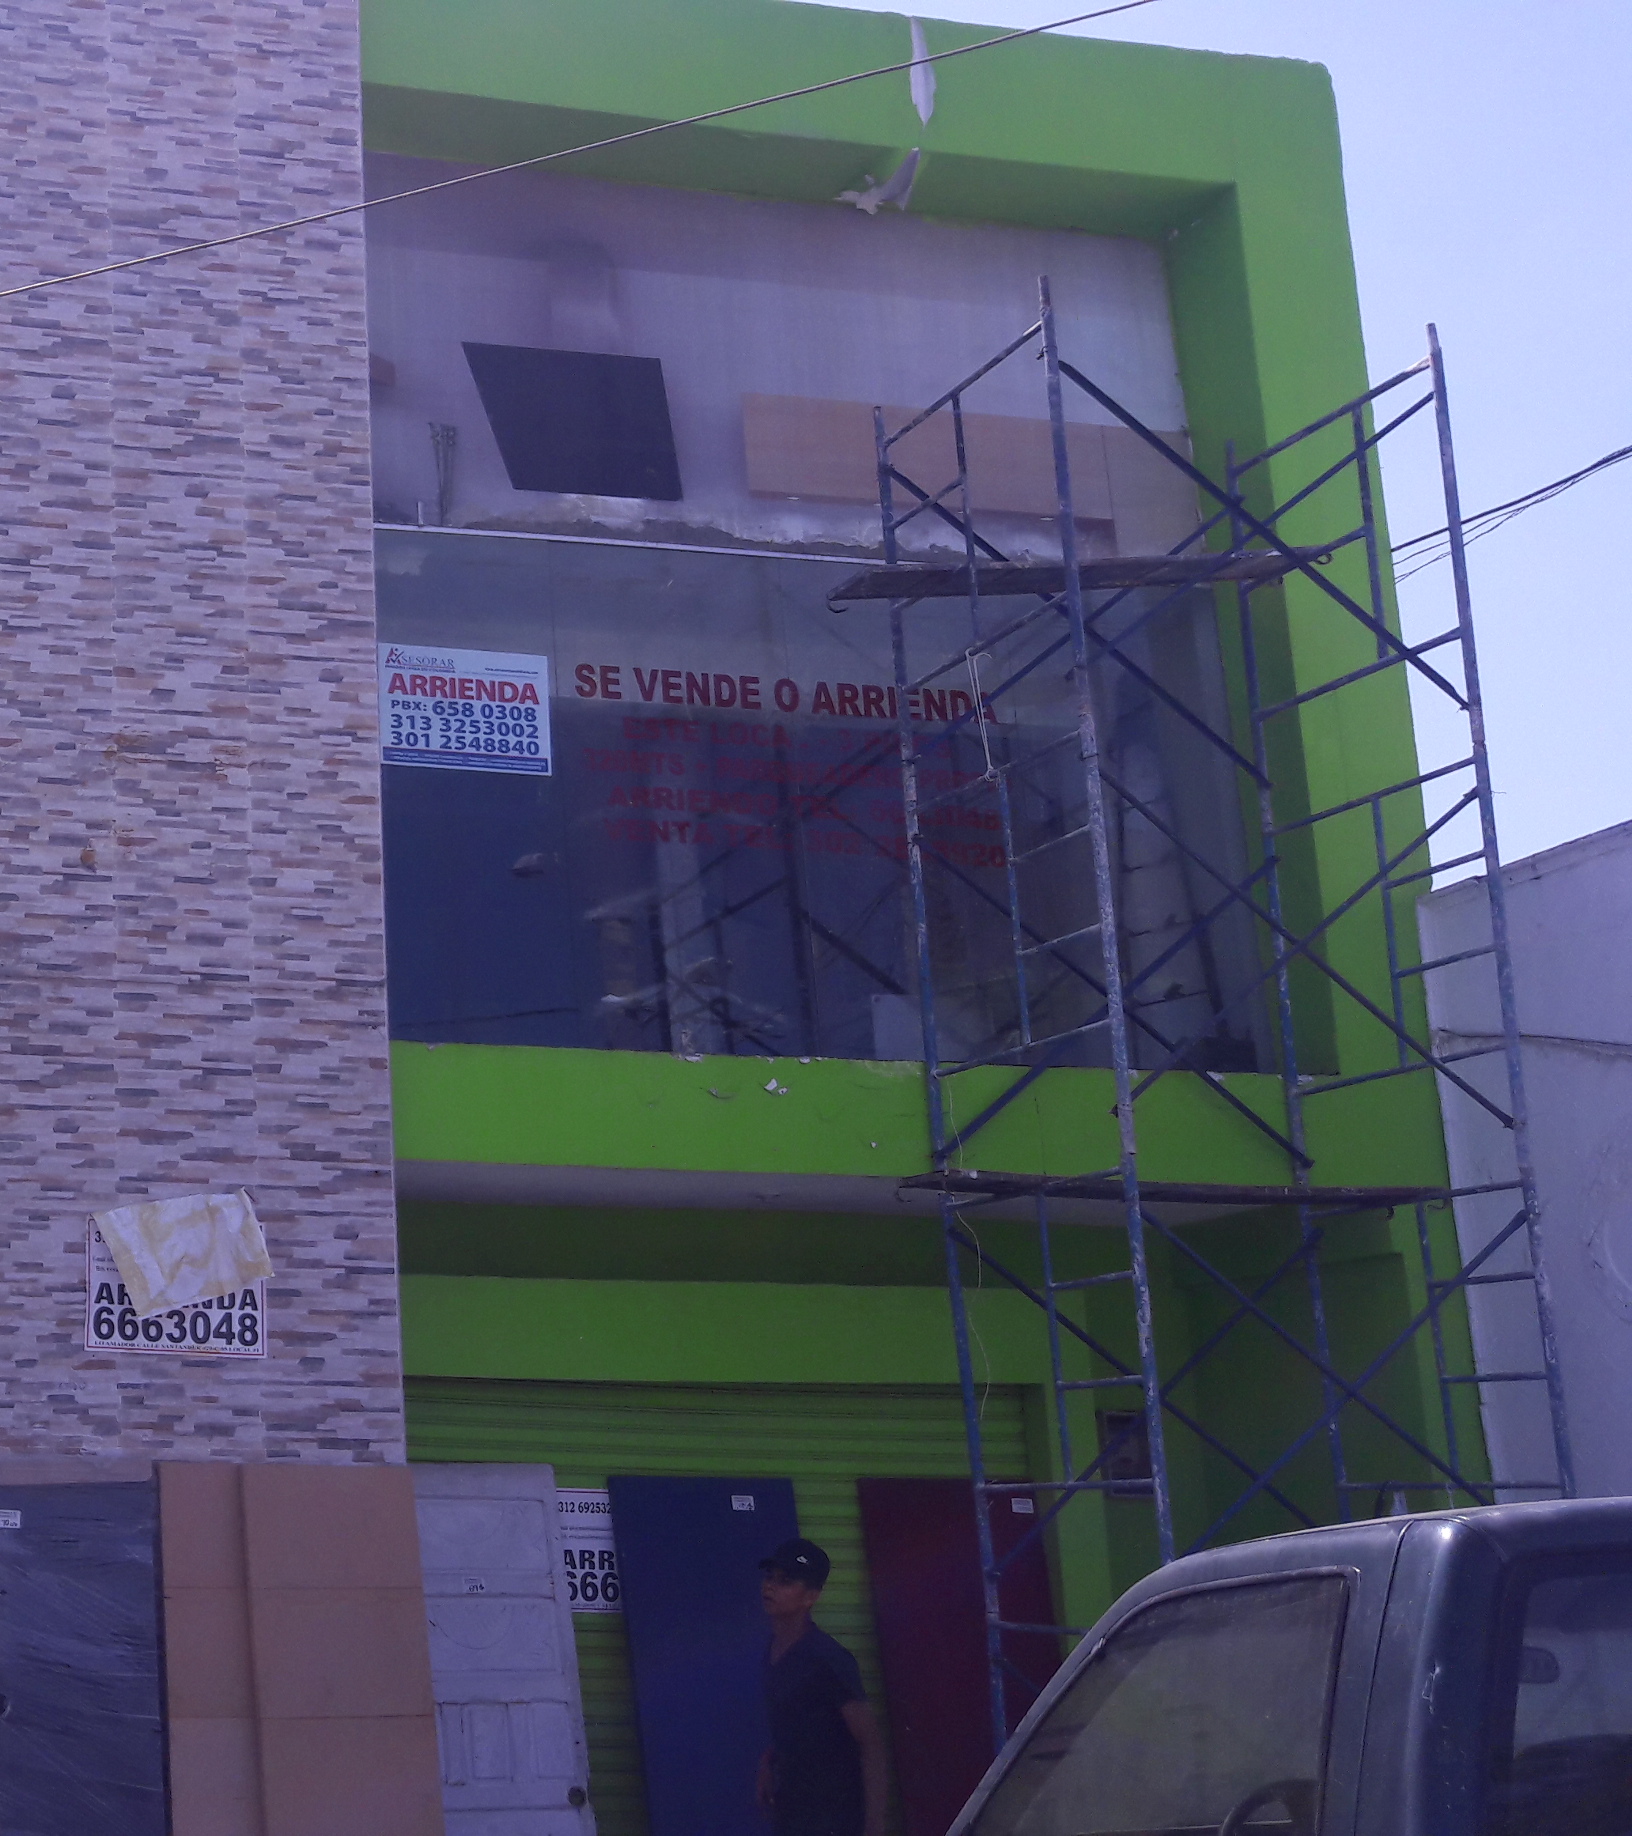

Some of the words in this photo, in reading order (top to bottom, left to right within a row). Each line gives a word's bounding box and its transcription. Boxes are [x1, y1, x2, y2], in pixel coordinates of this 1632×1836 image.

[387, 673, 540, 705] ARRIENDA
[575, 663, 622, 699] SE
[633, 667, 762, 710] VENDE
[774, 678, 800, 712] O
[390, 700, 428, 712] PBX:
[432, 701, 475, 718] 658
[480, 704, 537, 722] 0308
[390, 714, 432, 731] 313
[439, 717, 539, 739] 3253002
[623, 716, 700, 743] ESTE
[710, 721, 809, 748] LOCA
[390, 731, 430, 748] 301
[439, 735, 540, 755] 2548840
[607, 785, 779, 816] ARRIENDO
[603, 818, 716, 844] VENTA
[93, 1306, 259, 1347] 6663048
[558, 1501, 575, 1513] 312
